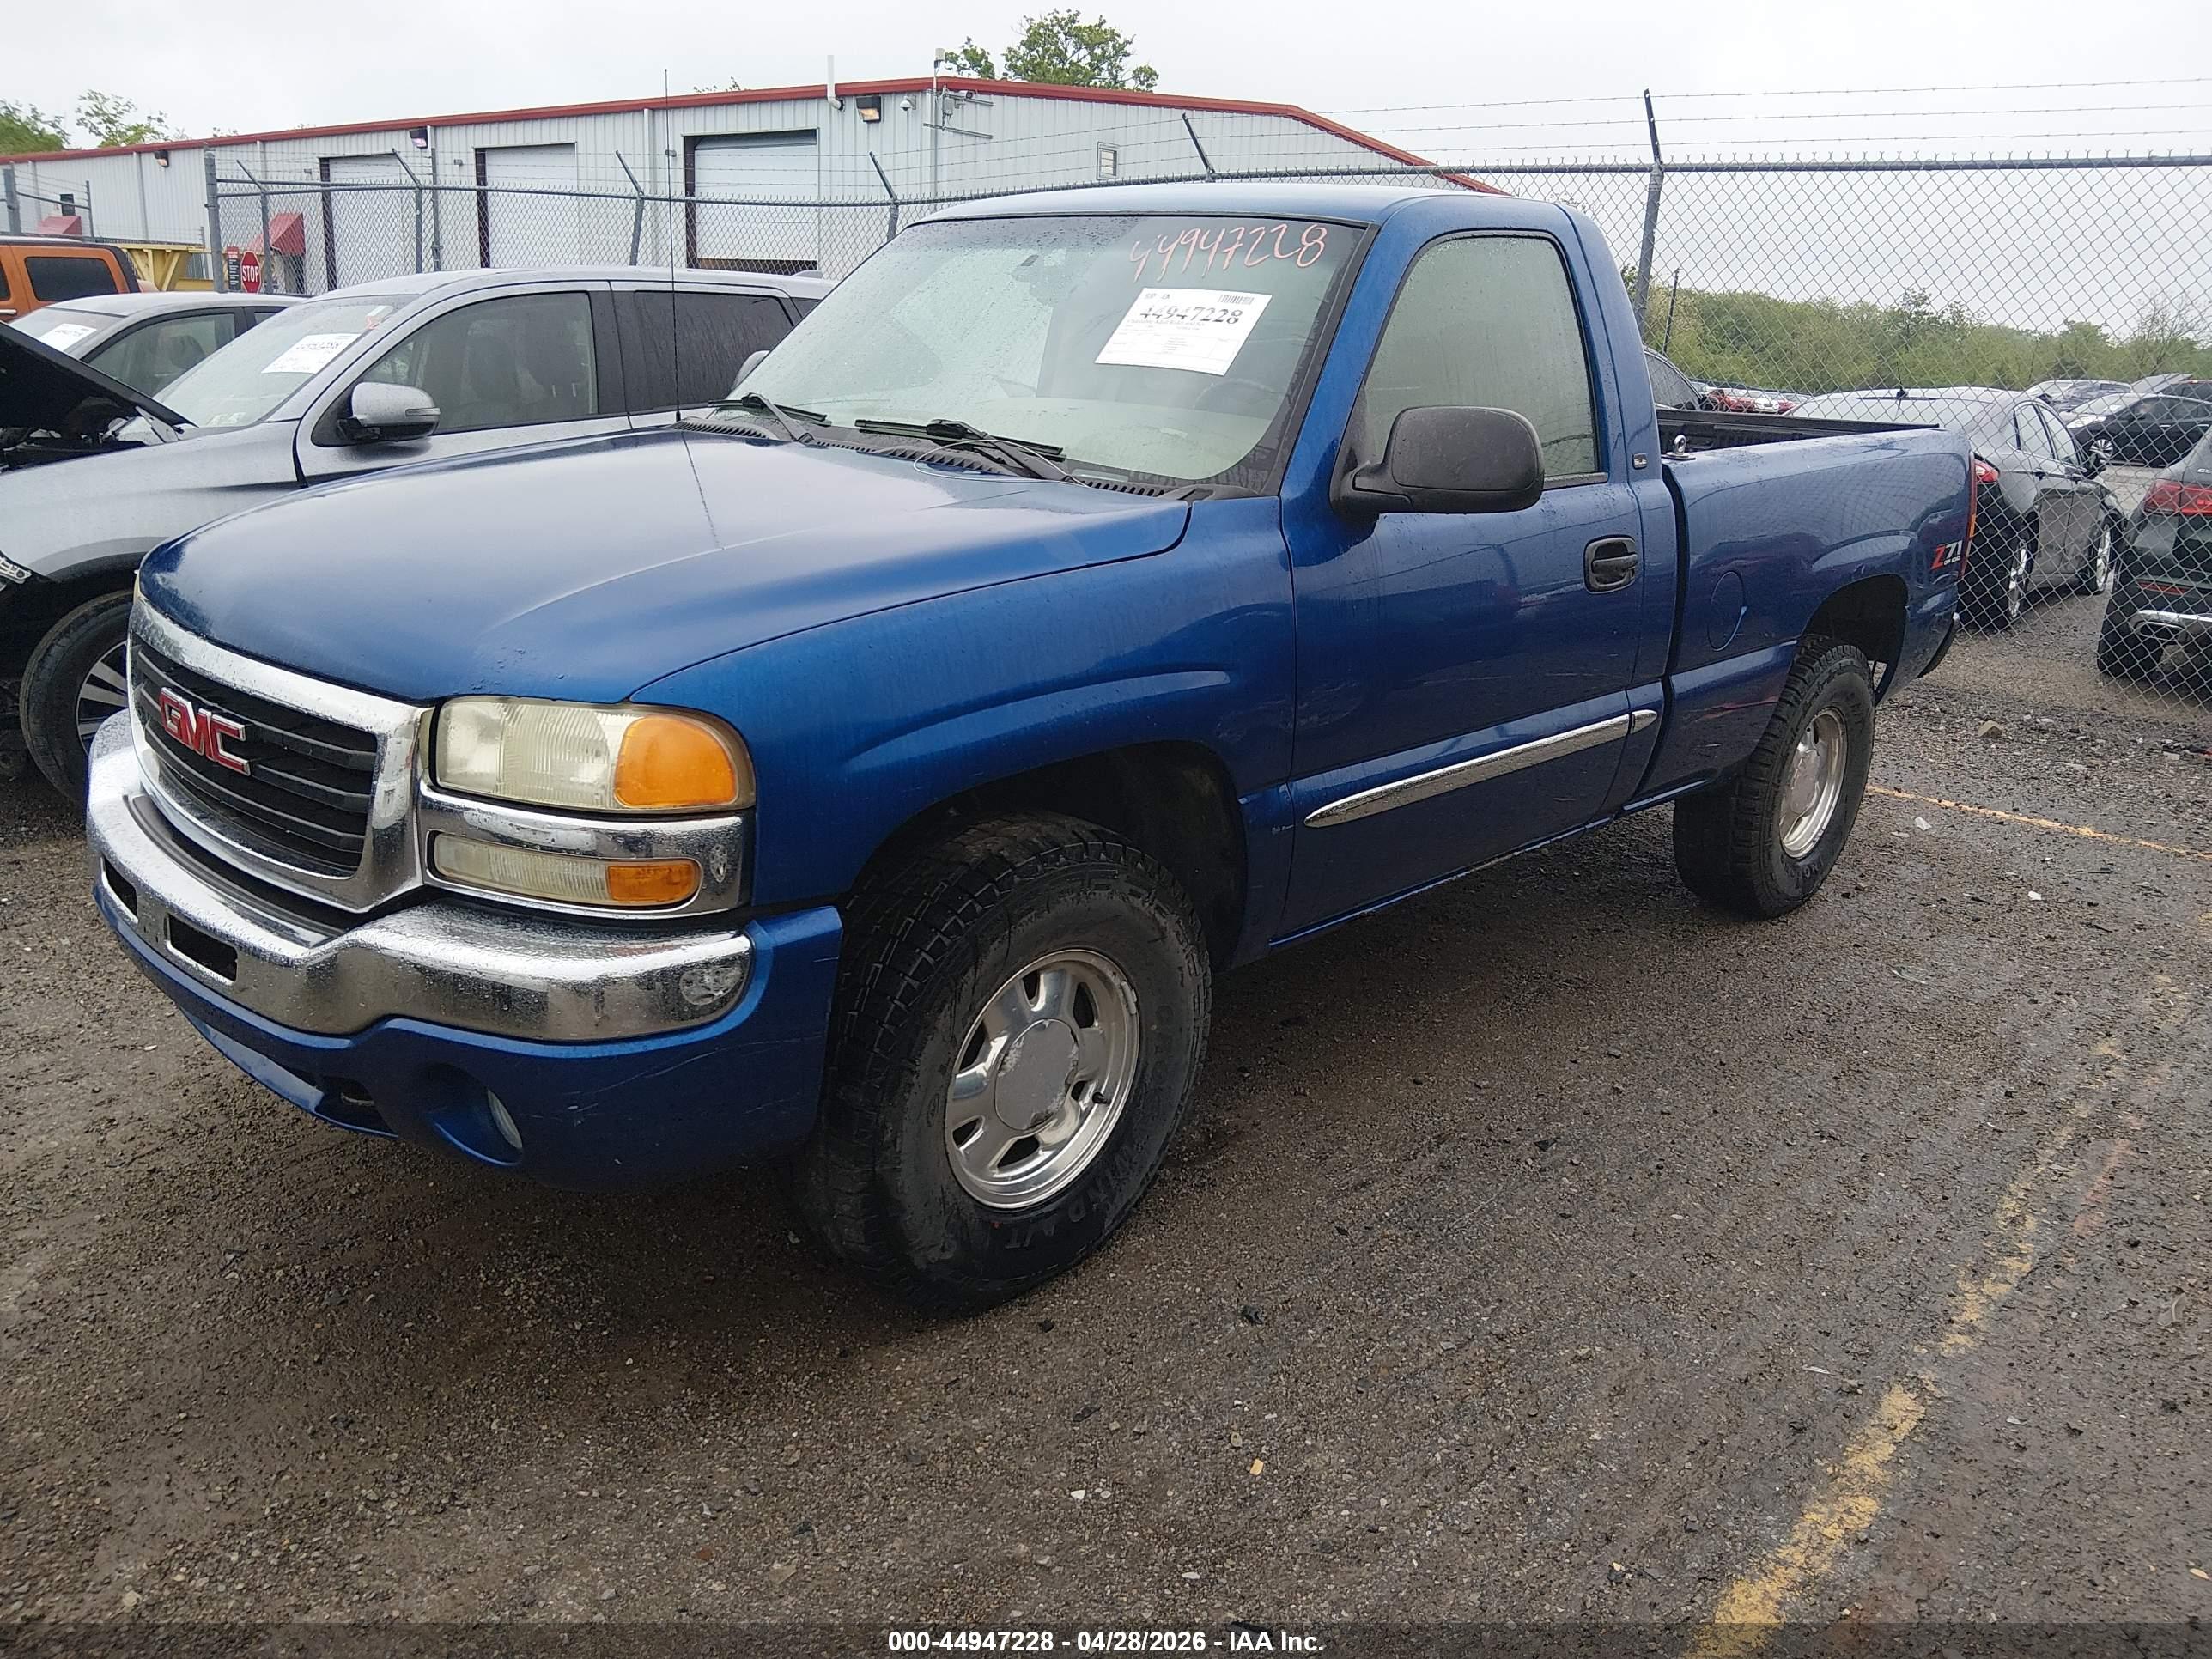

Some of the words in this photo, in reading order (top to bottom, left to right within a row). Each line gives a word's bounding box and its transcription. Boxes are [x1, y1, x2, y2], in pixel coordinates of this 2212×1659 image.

[242, 265, 259, 283] STOP
[1128, 222, 1328, 283] 44947228
[1931, 540, 1963, 570] Z71
[159, 686, 251, 776] GMC
